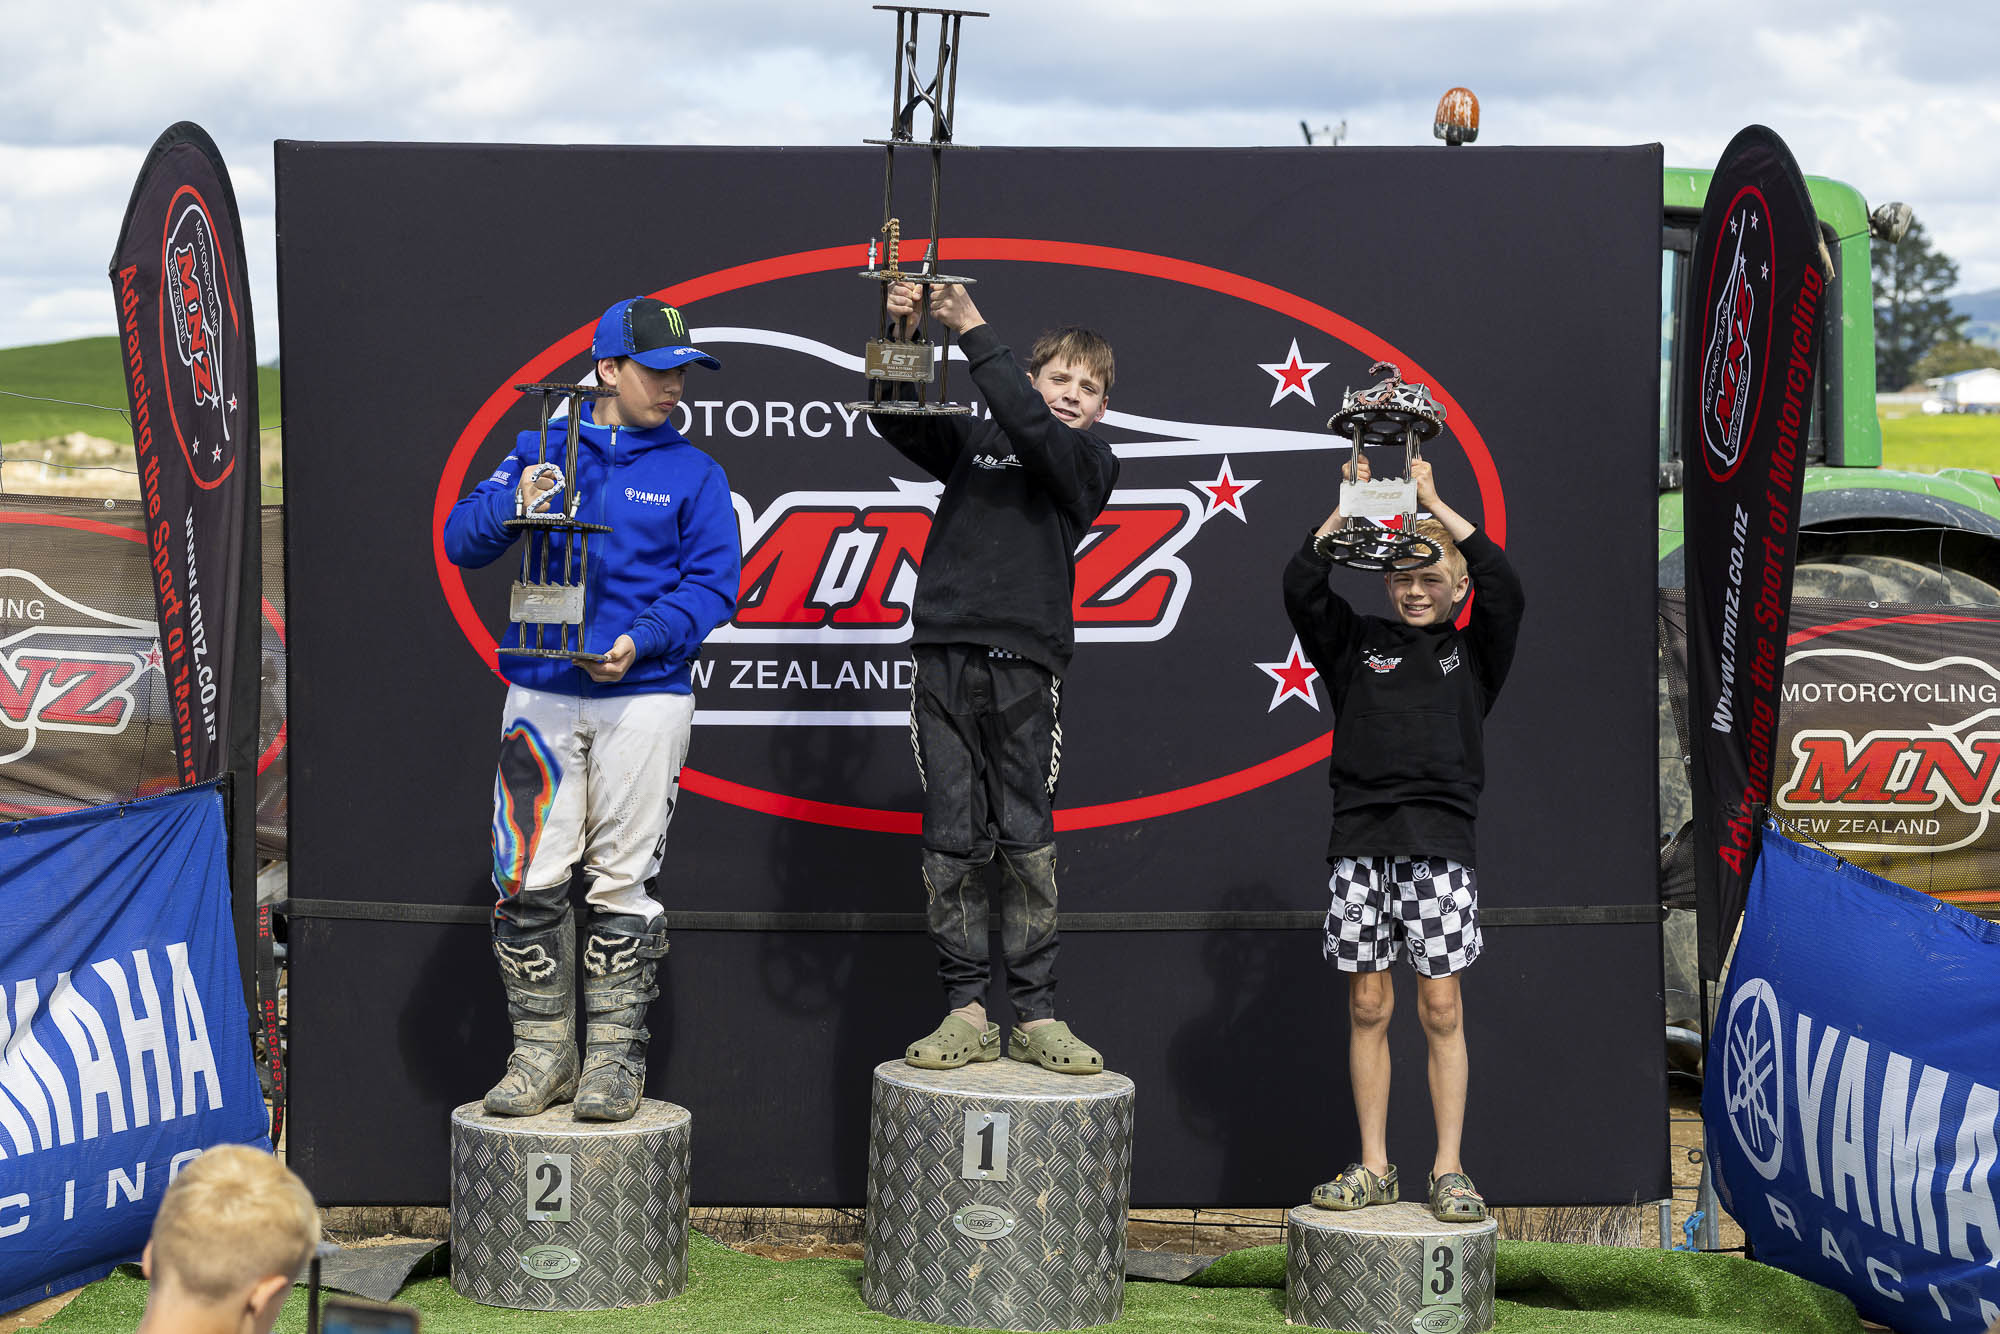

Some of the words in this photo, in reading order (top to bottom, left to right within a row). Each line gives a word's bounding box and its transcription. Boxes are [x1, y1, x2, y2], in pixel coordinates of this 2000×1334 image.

[169, 258, 178, 287] NEW
[195, 219, 219, 337] MOTORCYCLING
[173, 290, 187, 344] ZEALAND
[176, 248, 214, 400] MNZ
[879, 349, 920, 367] 1ST
[1705, 301, 1728, 414] MOTORCYCLING
[1716, 272, 1751, 440] MNZ
[1768, 263, 1824, 492] Motorcycling
[1729, 425, 1740, 453] NEW
[1735, 370, 1748, 425] ZEALAND
[119, 263, 154, 456] Advancing
[144, 455, 162, 519] the
[153, 520, 184, 625] Sport
[635, 490, 671, 503] YAMAHA
[1769, 488, 1790, 536] of
[1753, 533, 1788, 632] Sport
[1711, 503, 1750, 736] www.mnz.co.nz
[729, 659, 914, 690] ZEALAND
[1750, 635, 1777, 693] the
[1780, 683, 1998, 703] MOTORCYCLING
[1717, 699, 1775, 876] Advancing
[1786, 738, 2000, 804] MN
[1782, 818, 1830, 834] NEW
[1836, 819, 1941, 835] ZEALAND
[0, 941, 224, 1160] MAHA
[264, 999, 284, 1093] AEROFAST
[976, 1121, 995, 1170] 1
[535, 1163, 563, 1211] 2
[969, 1219, 994, 1228] MNZ
[1430, 1245, 1455, 1295] 3
